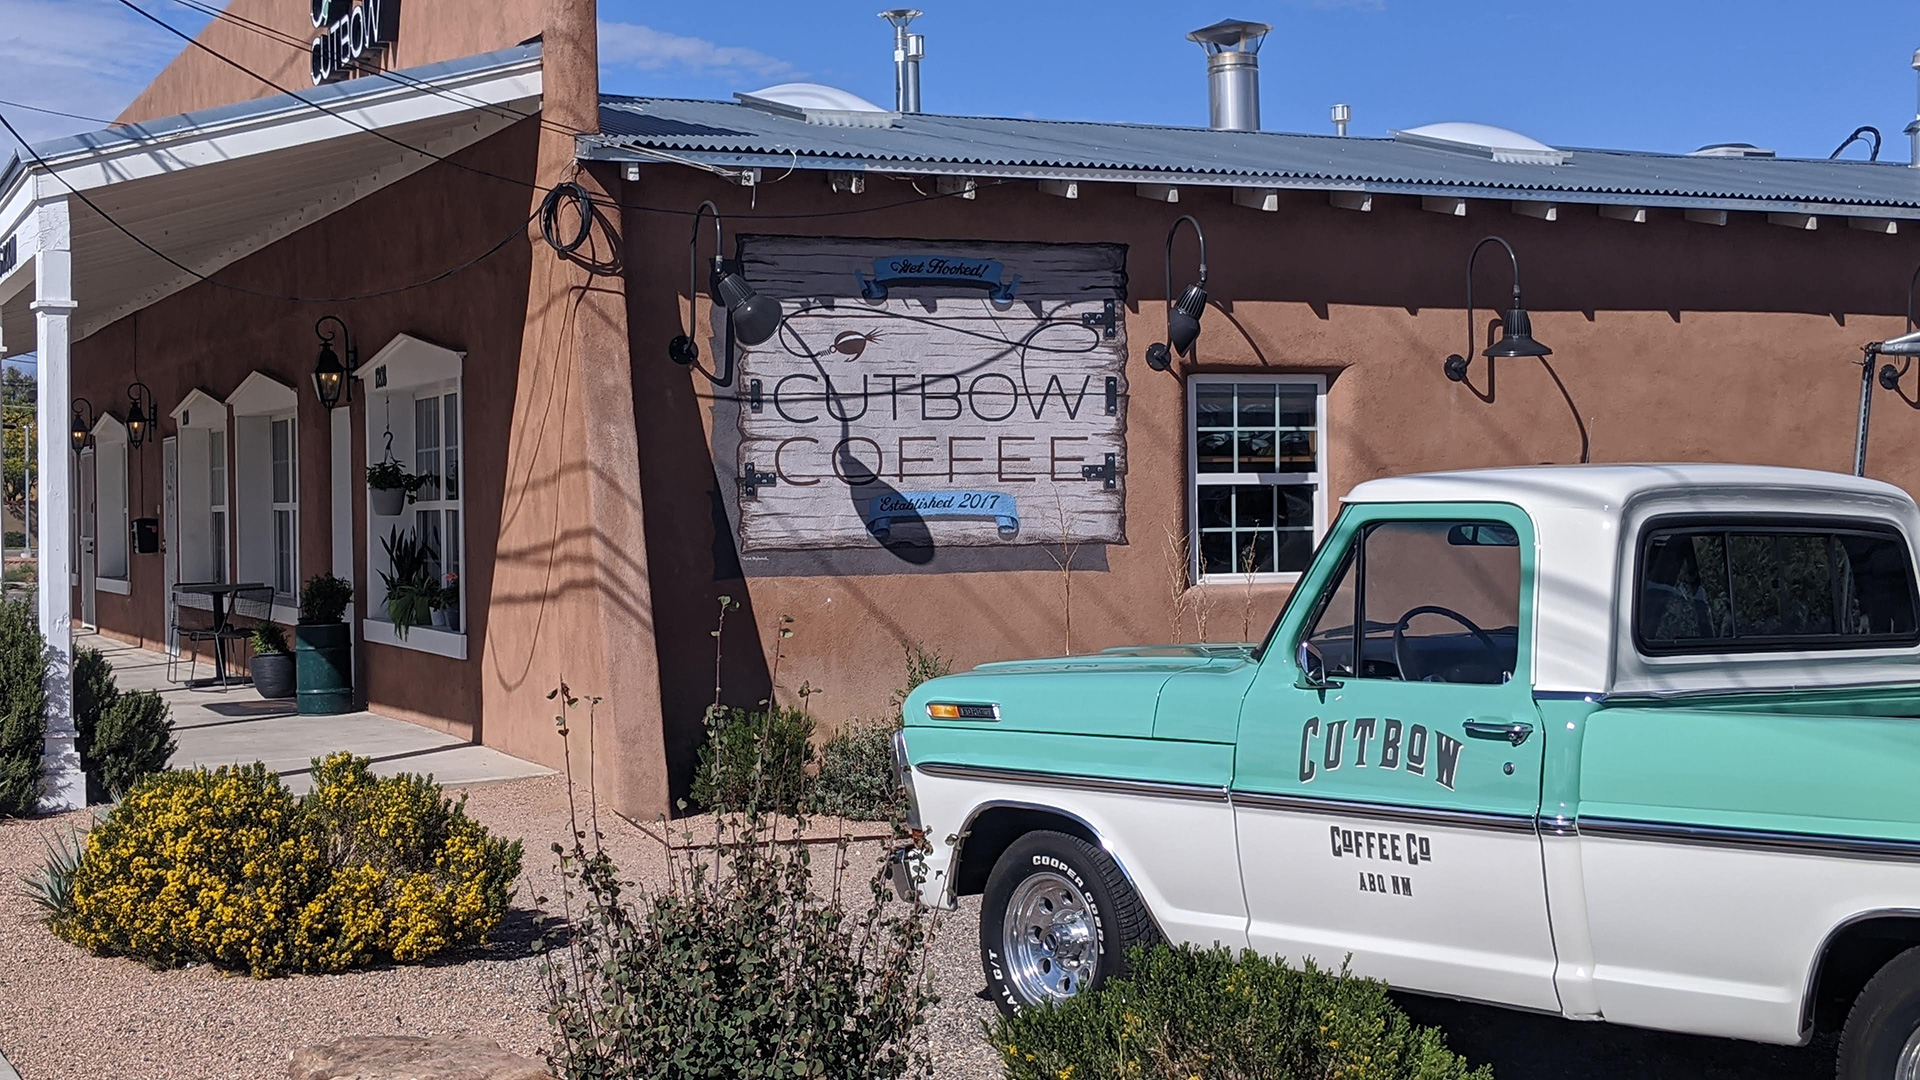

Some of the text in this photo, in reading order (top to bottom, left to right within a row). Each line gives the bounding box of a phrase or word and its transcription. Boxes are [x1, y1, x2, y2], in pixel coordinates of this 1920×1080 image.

[310, 0, 380, 86] CUTBOW
[890, 258, 990, 278] Get Hooked!
[773, 373, 1091, 424] CUTBOW
[774, 436, 1089, 486] COFFEE
[879, 493, 1001, 512] Established 2017
[1298, 716, 1464, 792] CUTBOW
[1032, 855, 1084, 888] COOPER
[1390, 875, 1413, 897] NM
